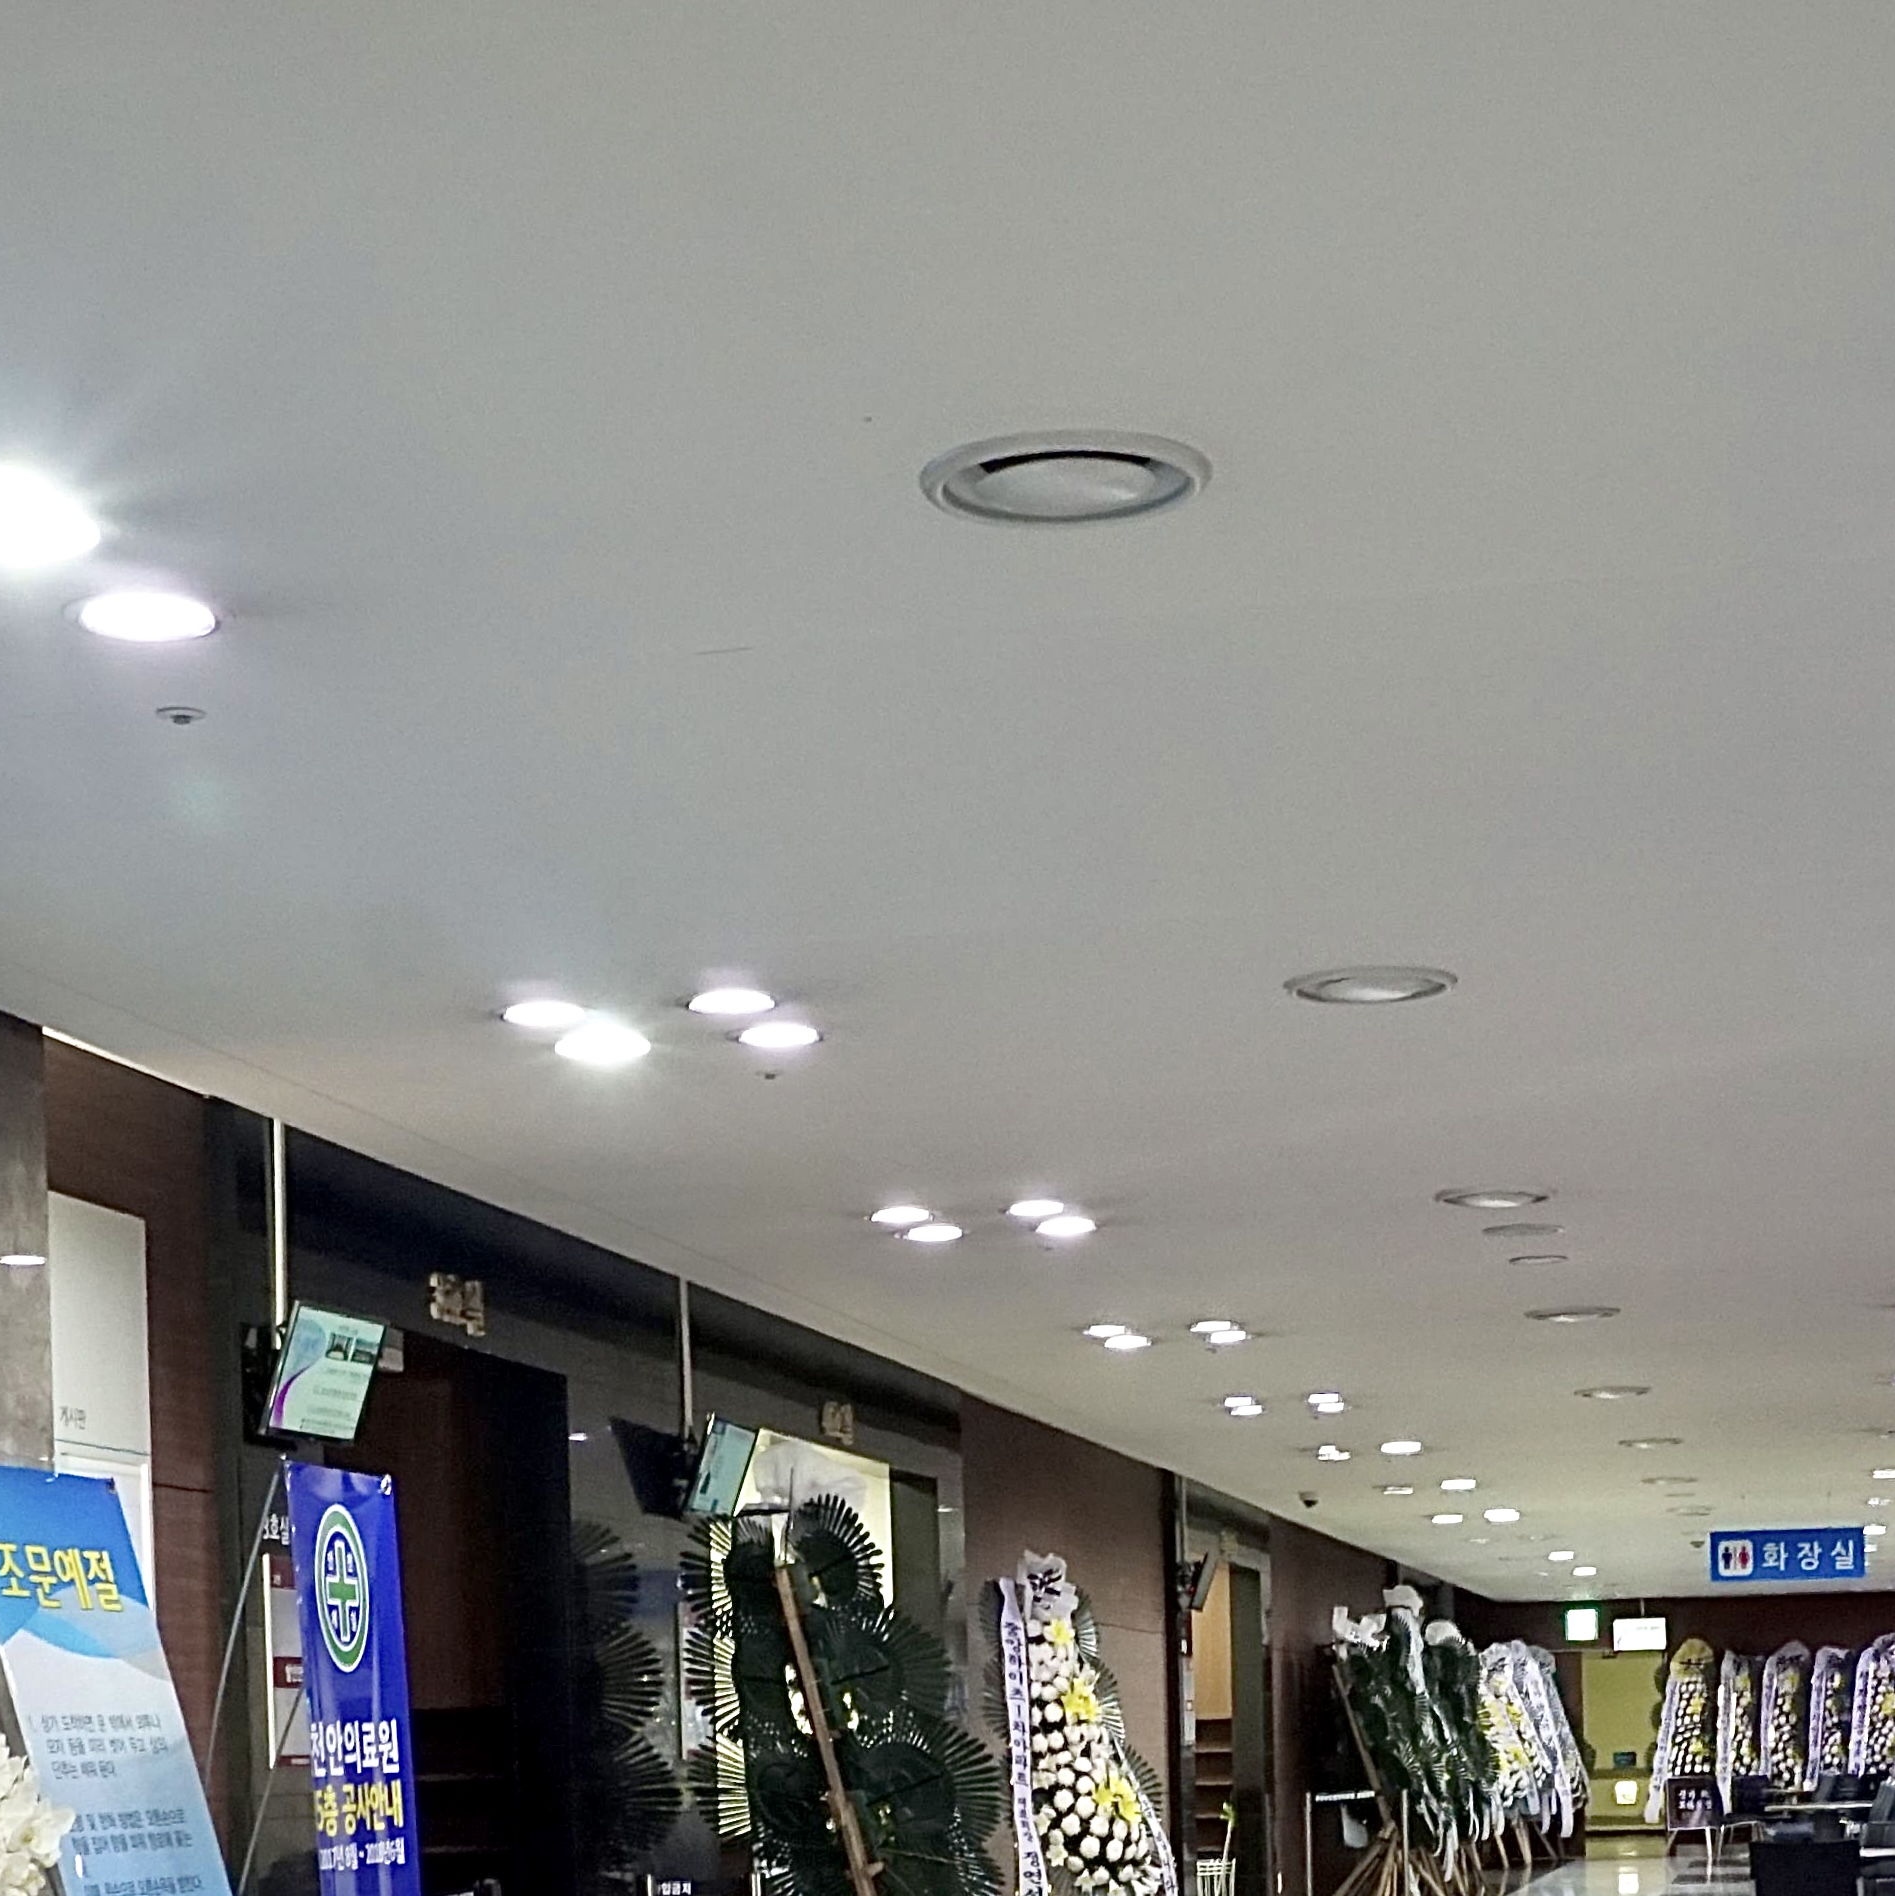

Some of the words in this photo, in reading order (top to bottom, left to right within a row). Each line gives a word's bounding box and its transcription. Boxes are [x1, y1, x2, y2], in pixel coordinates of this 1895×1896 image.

[1761, 1539, 1855, 1572] 화장실
[310, 1718, 400, 1778] 천안의료원
[313, 1783, 339, 1837] 5층
[342, 1779, 404, 1836] 공사안내
[657, 1880, 692, 1896] 입금지
